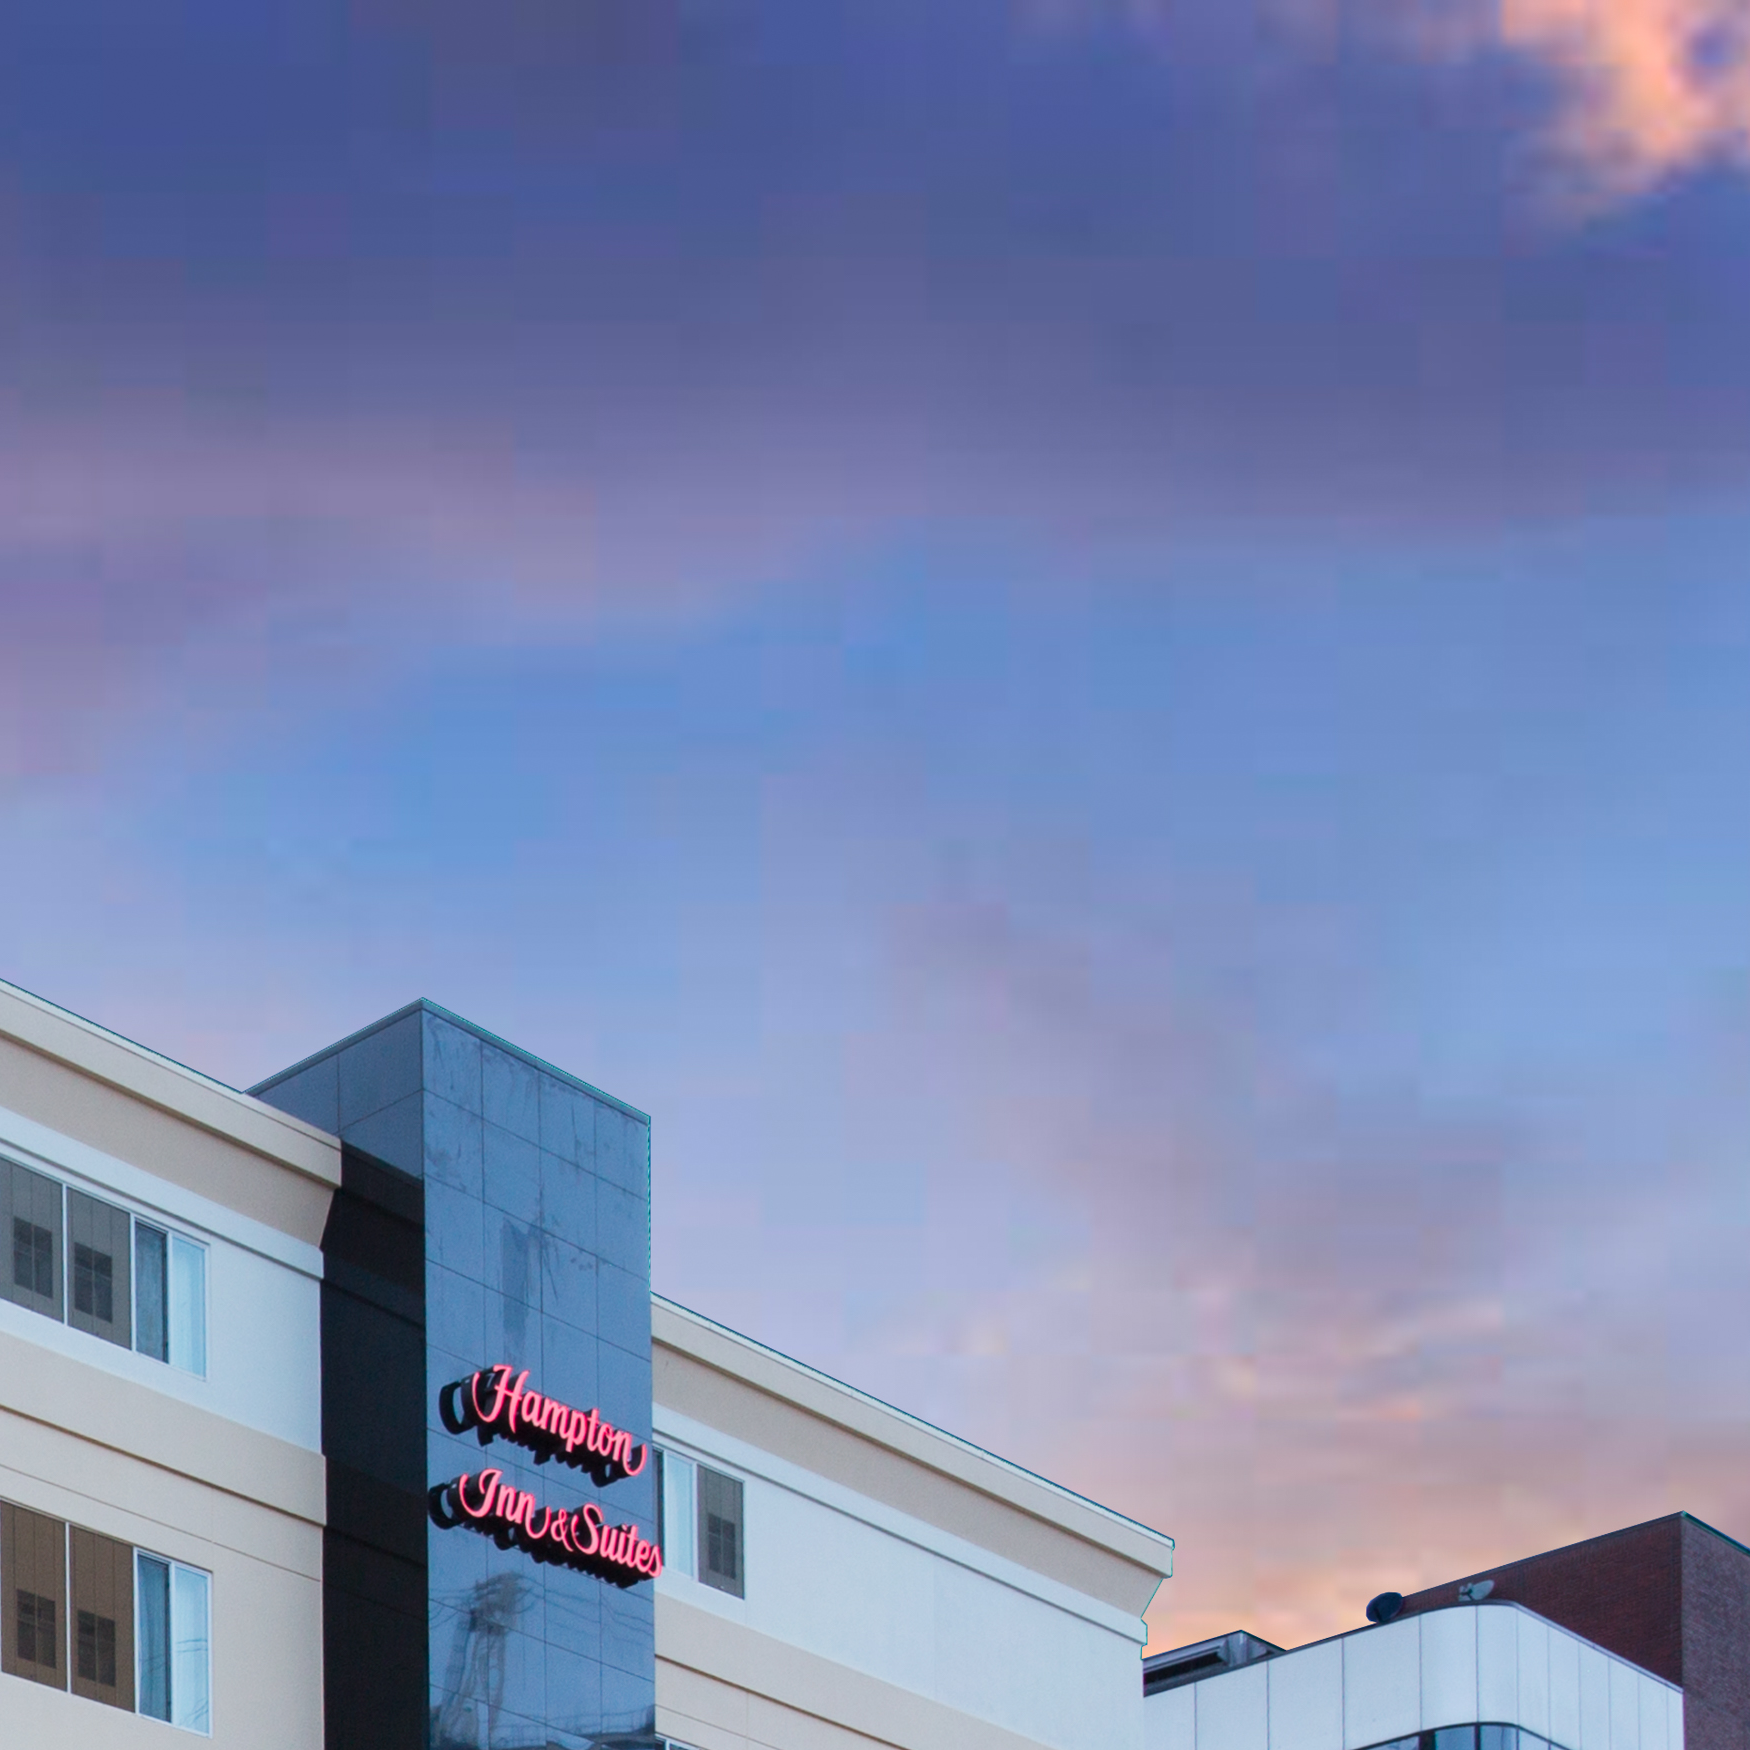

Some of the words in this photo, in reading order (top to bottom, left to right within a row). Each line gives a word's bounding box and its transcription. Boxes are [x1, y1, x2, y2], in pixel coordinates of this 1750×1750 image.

[471, 1364, 647, 1477] Hampton
[459, 1468, 550, 1539] Inn
[550, 1508, 575, 1552] &
[571, 1503, 663, 1578] Suites
